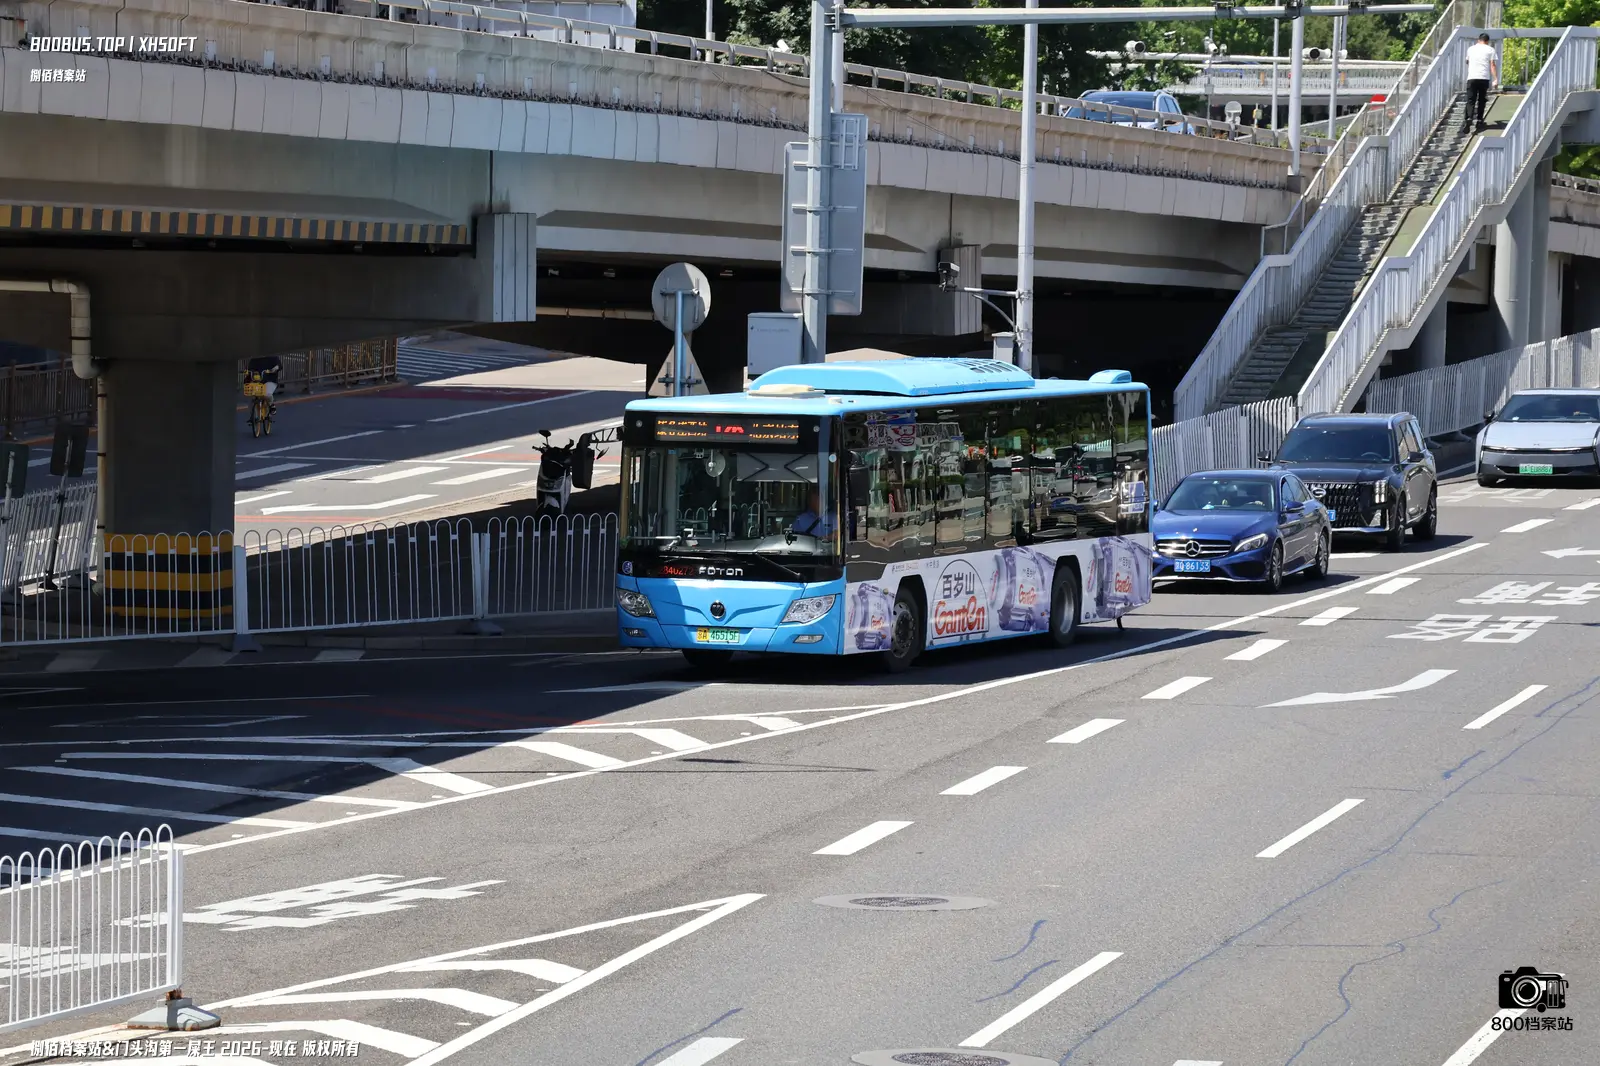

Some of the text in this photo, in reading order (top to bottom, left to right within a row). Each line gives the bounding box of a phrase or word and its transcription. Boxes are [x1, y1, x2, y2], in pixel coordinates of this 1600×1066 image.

[698, 566, 744, 576] FOTON
[942, 571, 975, 599] 百岁山
